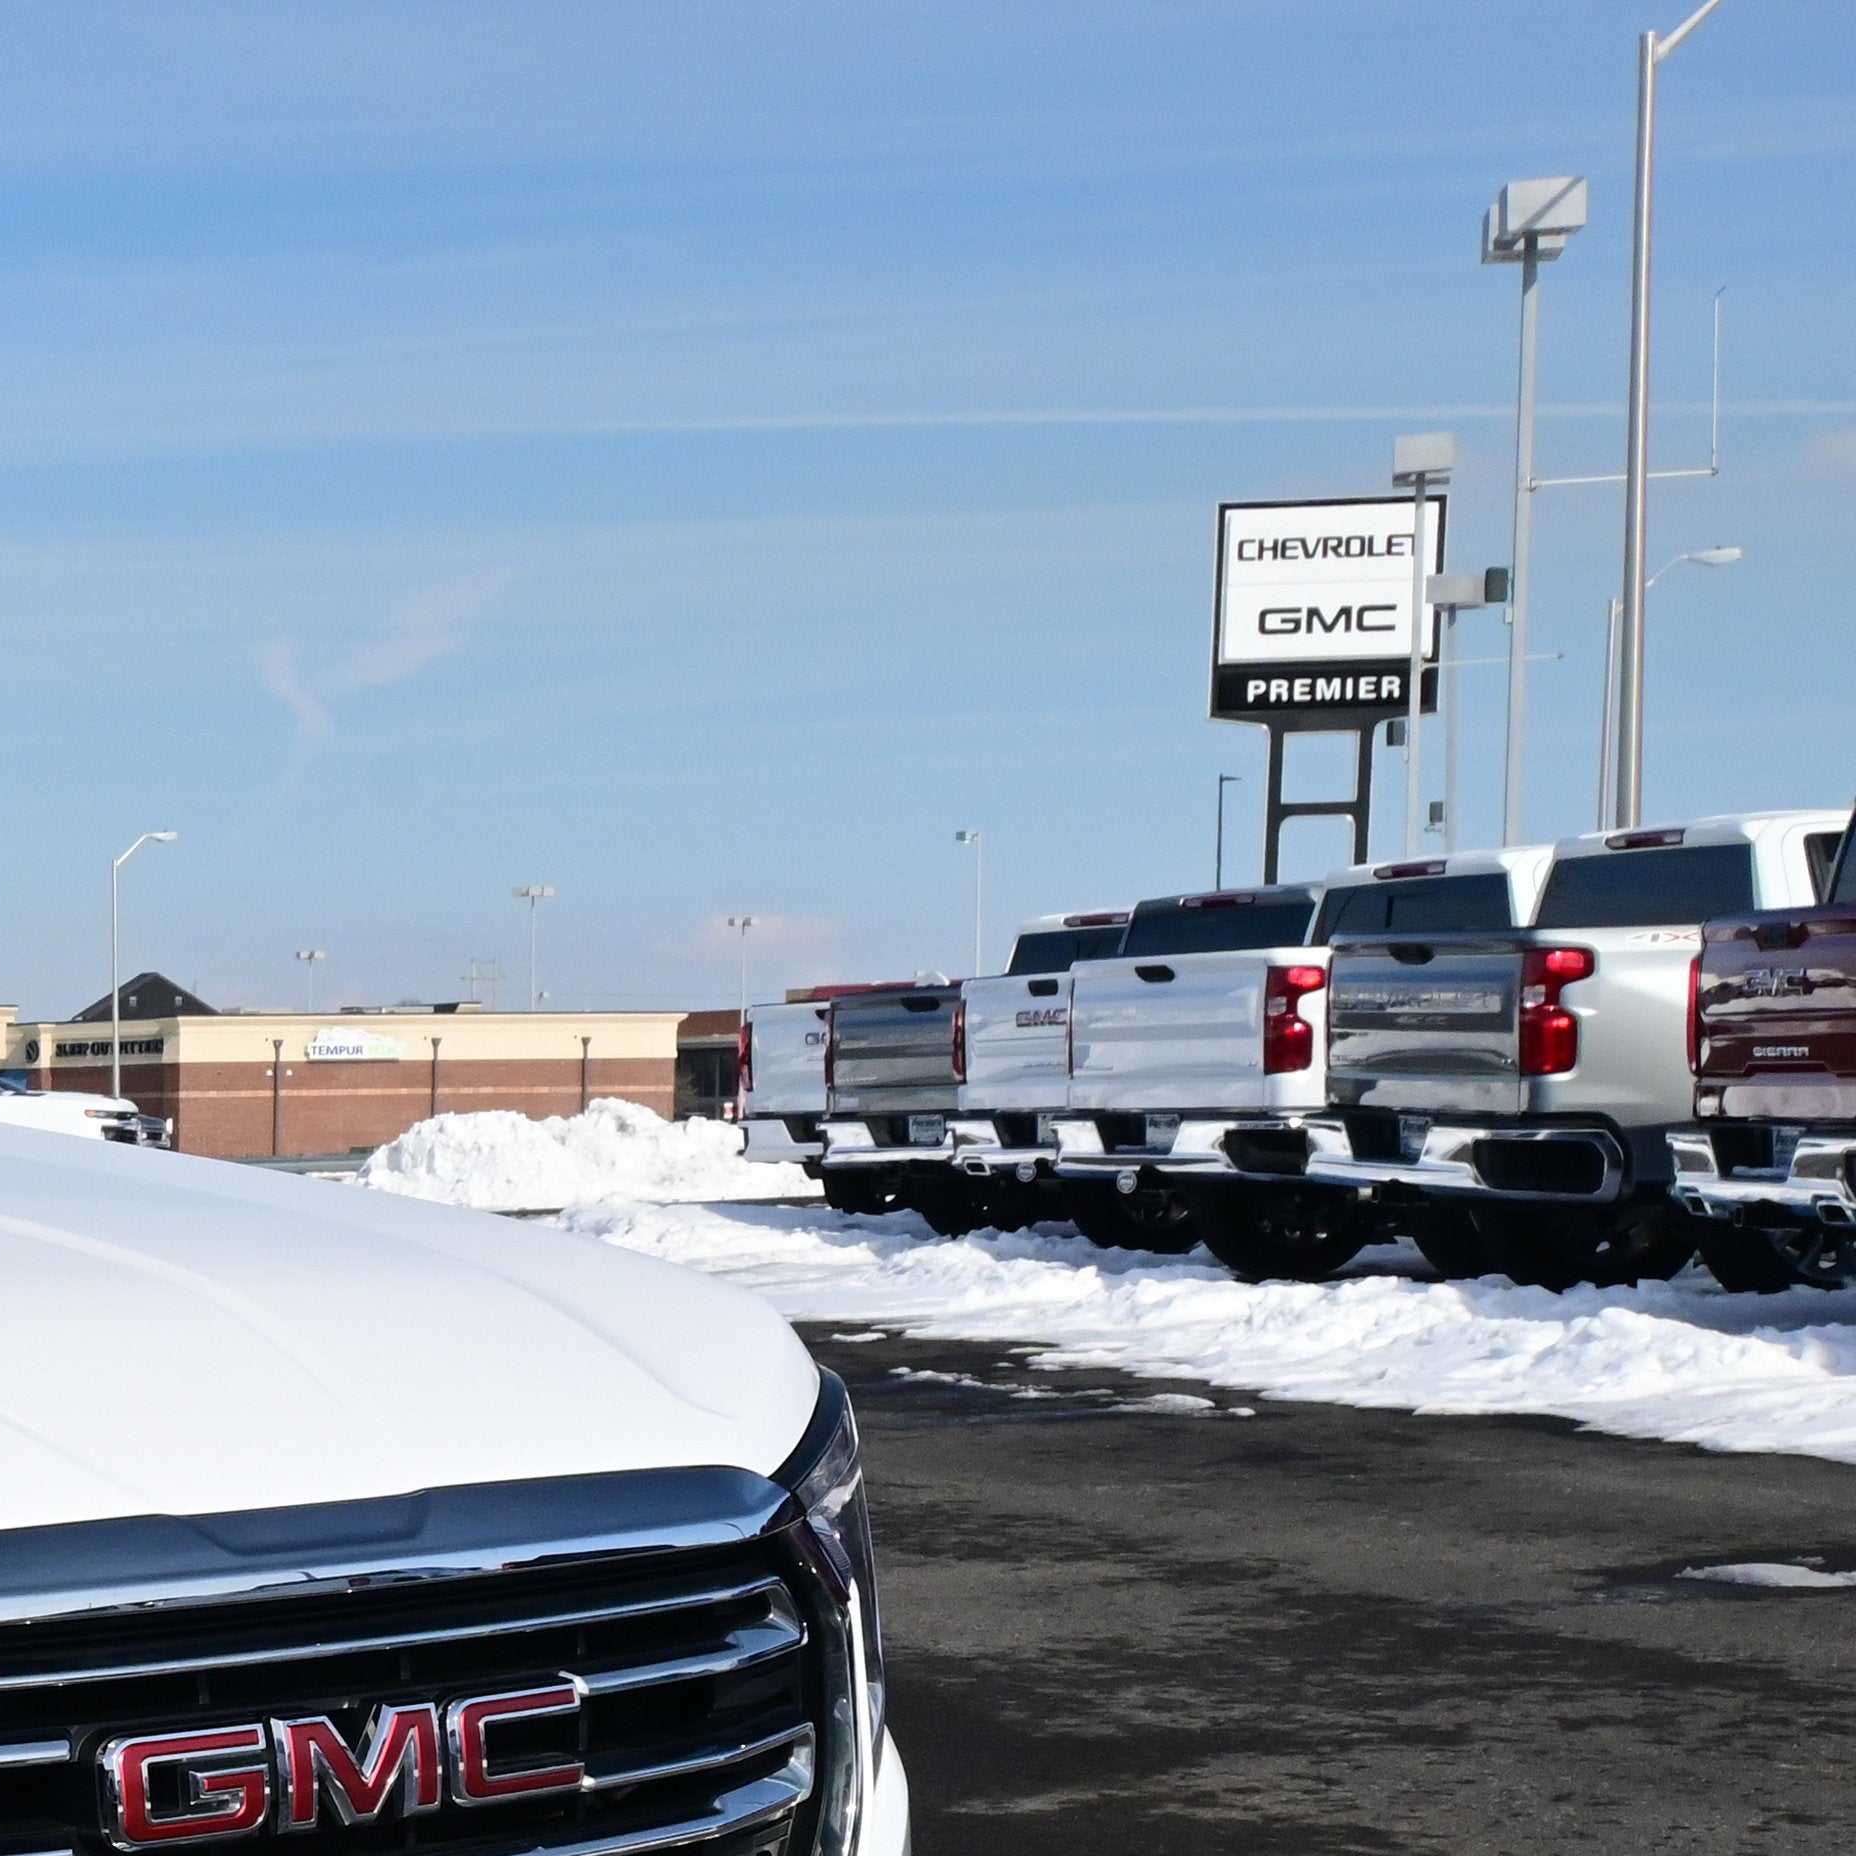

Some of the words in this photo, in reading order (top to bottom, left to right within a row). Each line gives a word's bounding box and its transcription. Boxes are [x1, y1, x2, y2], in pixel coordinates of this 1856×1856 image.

[1237, 533, 1415, 562] CHEVROLET
[1258, 603, 1397, 635] GMC
[1246, 675, 1401, 703] PREMIER
[1016, 1008, 1068, 1028] GMC
[310, 1045, 364, 1056] TEMPUR
[1752, 1046, 1810, 1057] SIERRA
[98, 1682, 586, 1852] GMC
